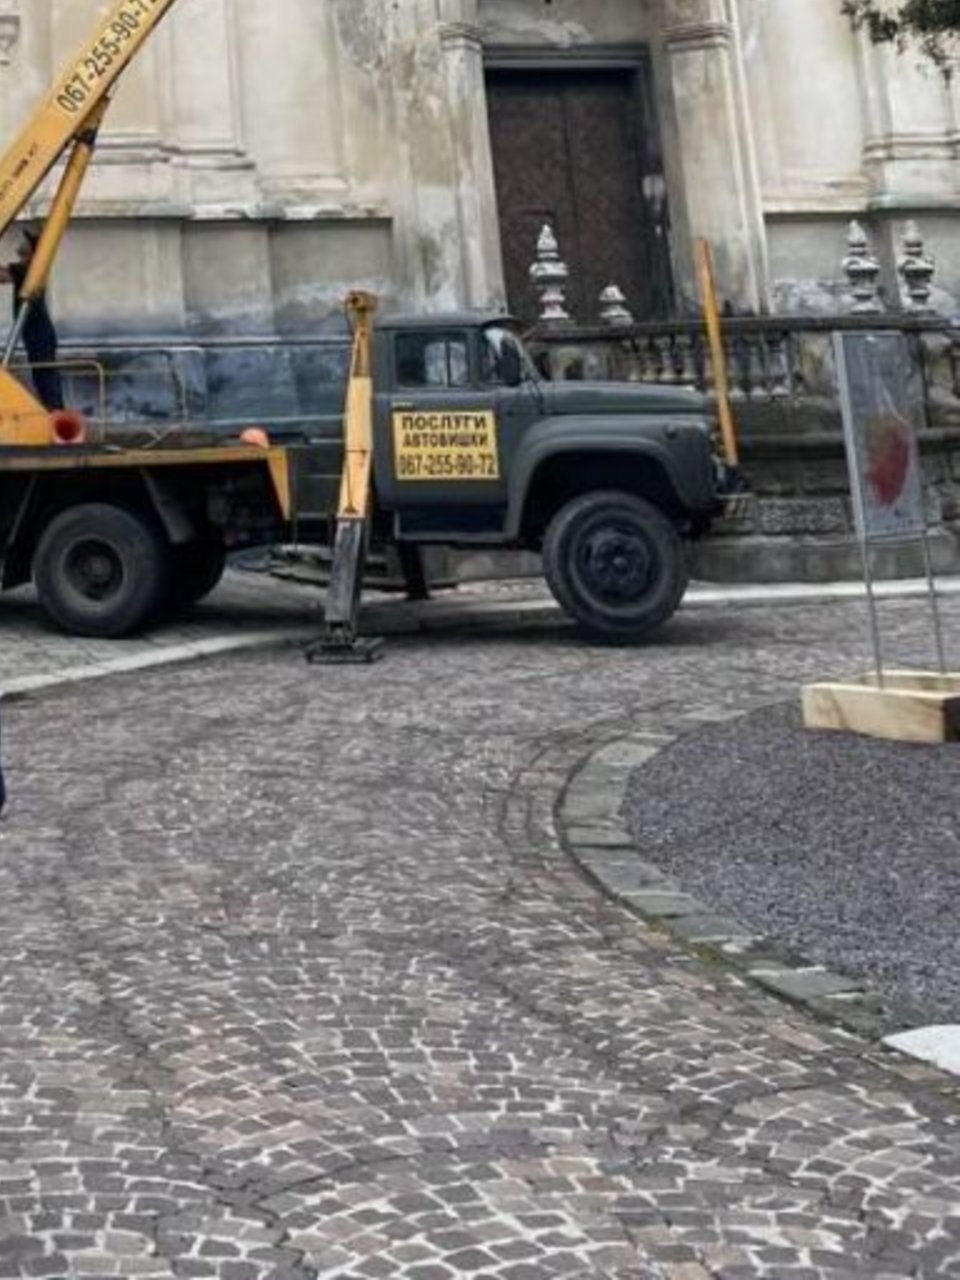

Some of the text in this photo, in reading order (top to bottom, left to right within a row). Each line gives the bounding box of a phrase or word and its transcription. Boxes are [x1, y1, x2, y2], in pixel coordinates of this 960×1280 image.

[401, 415, 487, 431] ПОСЛУГИ
[402, 432, 489, 448] АВТОВИШКИ
[399, 453, 495, 476] 067-255-90-72
